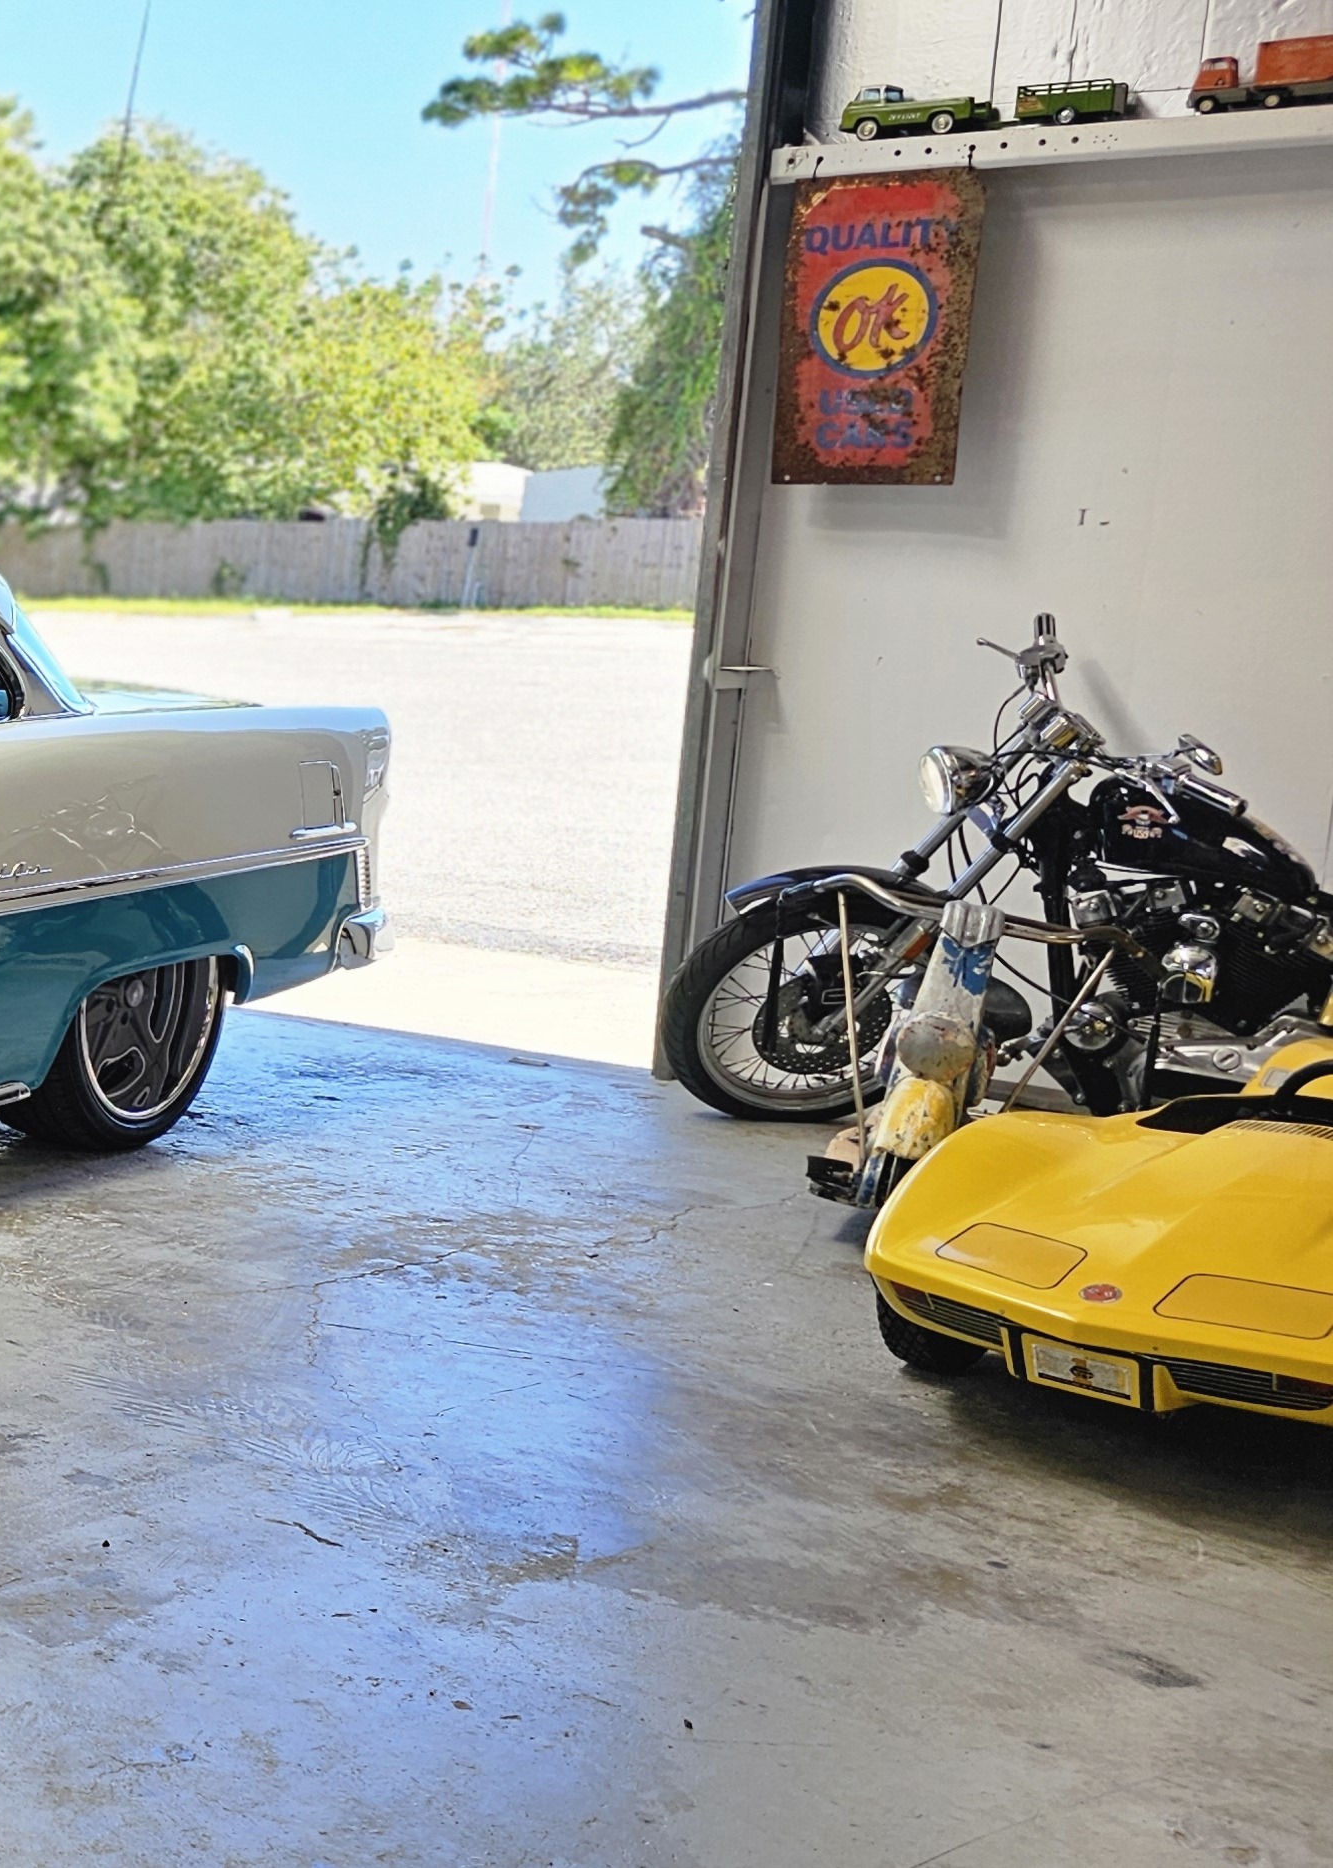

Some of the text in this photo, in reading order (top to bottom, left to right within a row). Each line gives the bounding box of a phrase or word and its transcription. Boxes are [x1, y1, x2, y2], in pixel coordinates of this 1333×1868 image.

[805, 219, 959, 254] QUALITY
[833, 283, 909, 352] OK
[816, 420, 913, 450] CARS
